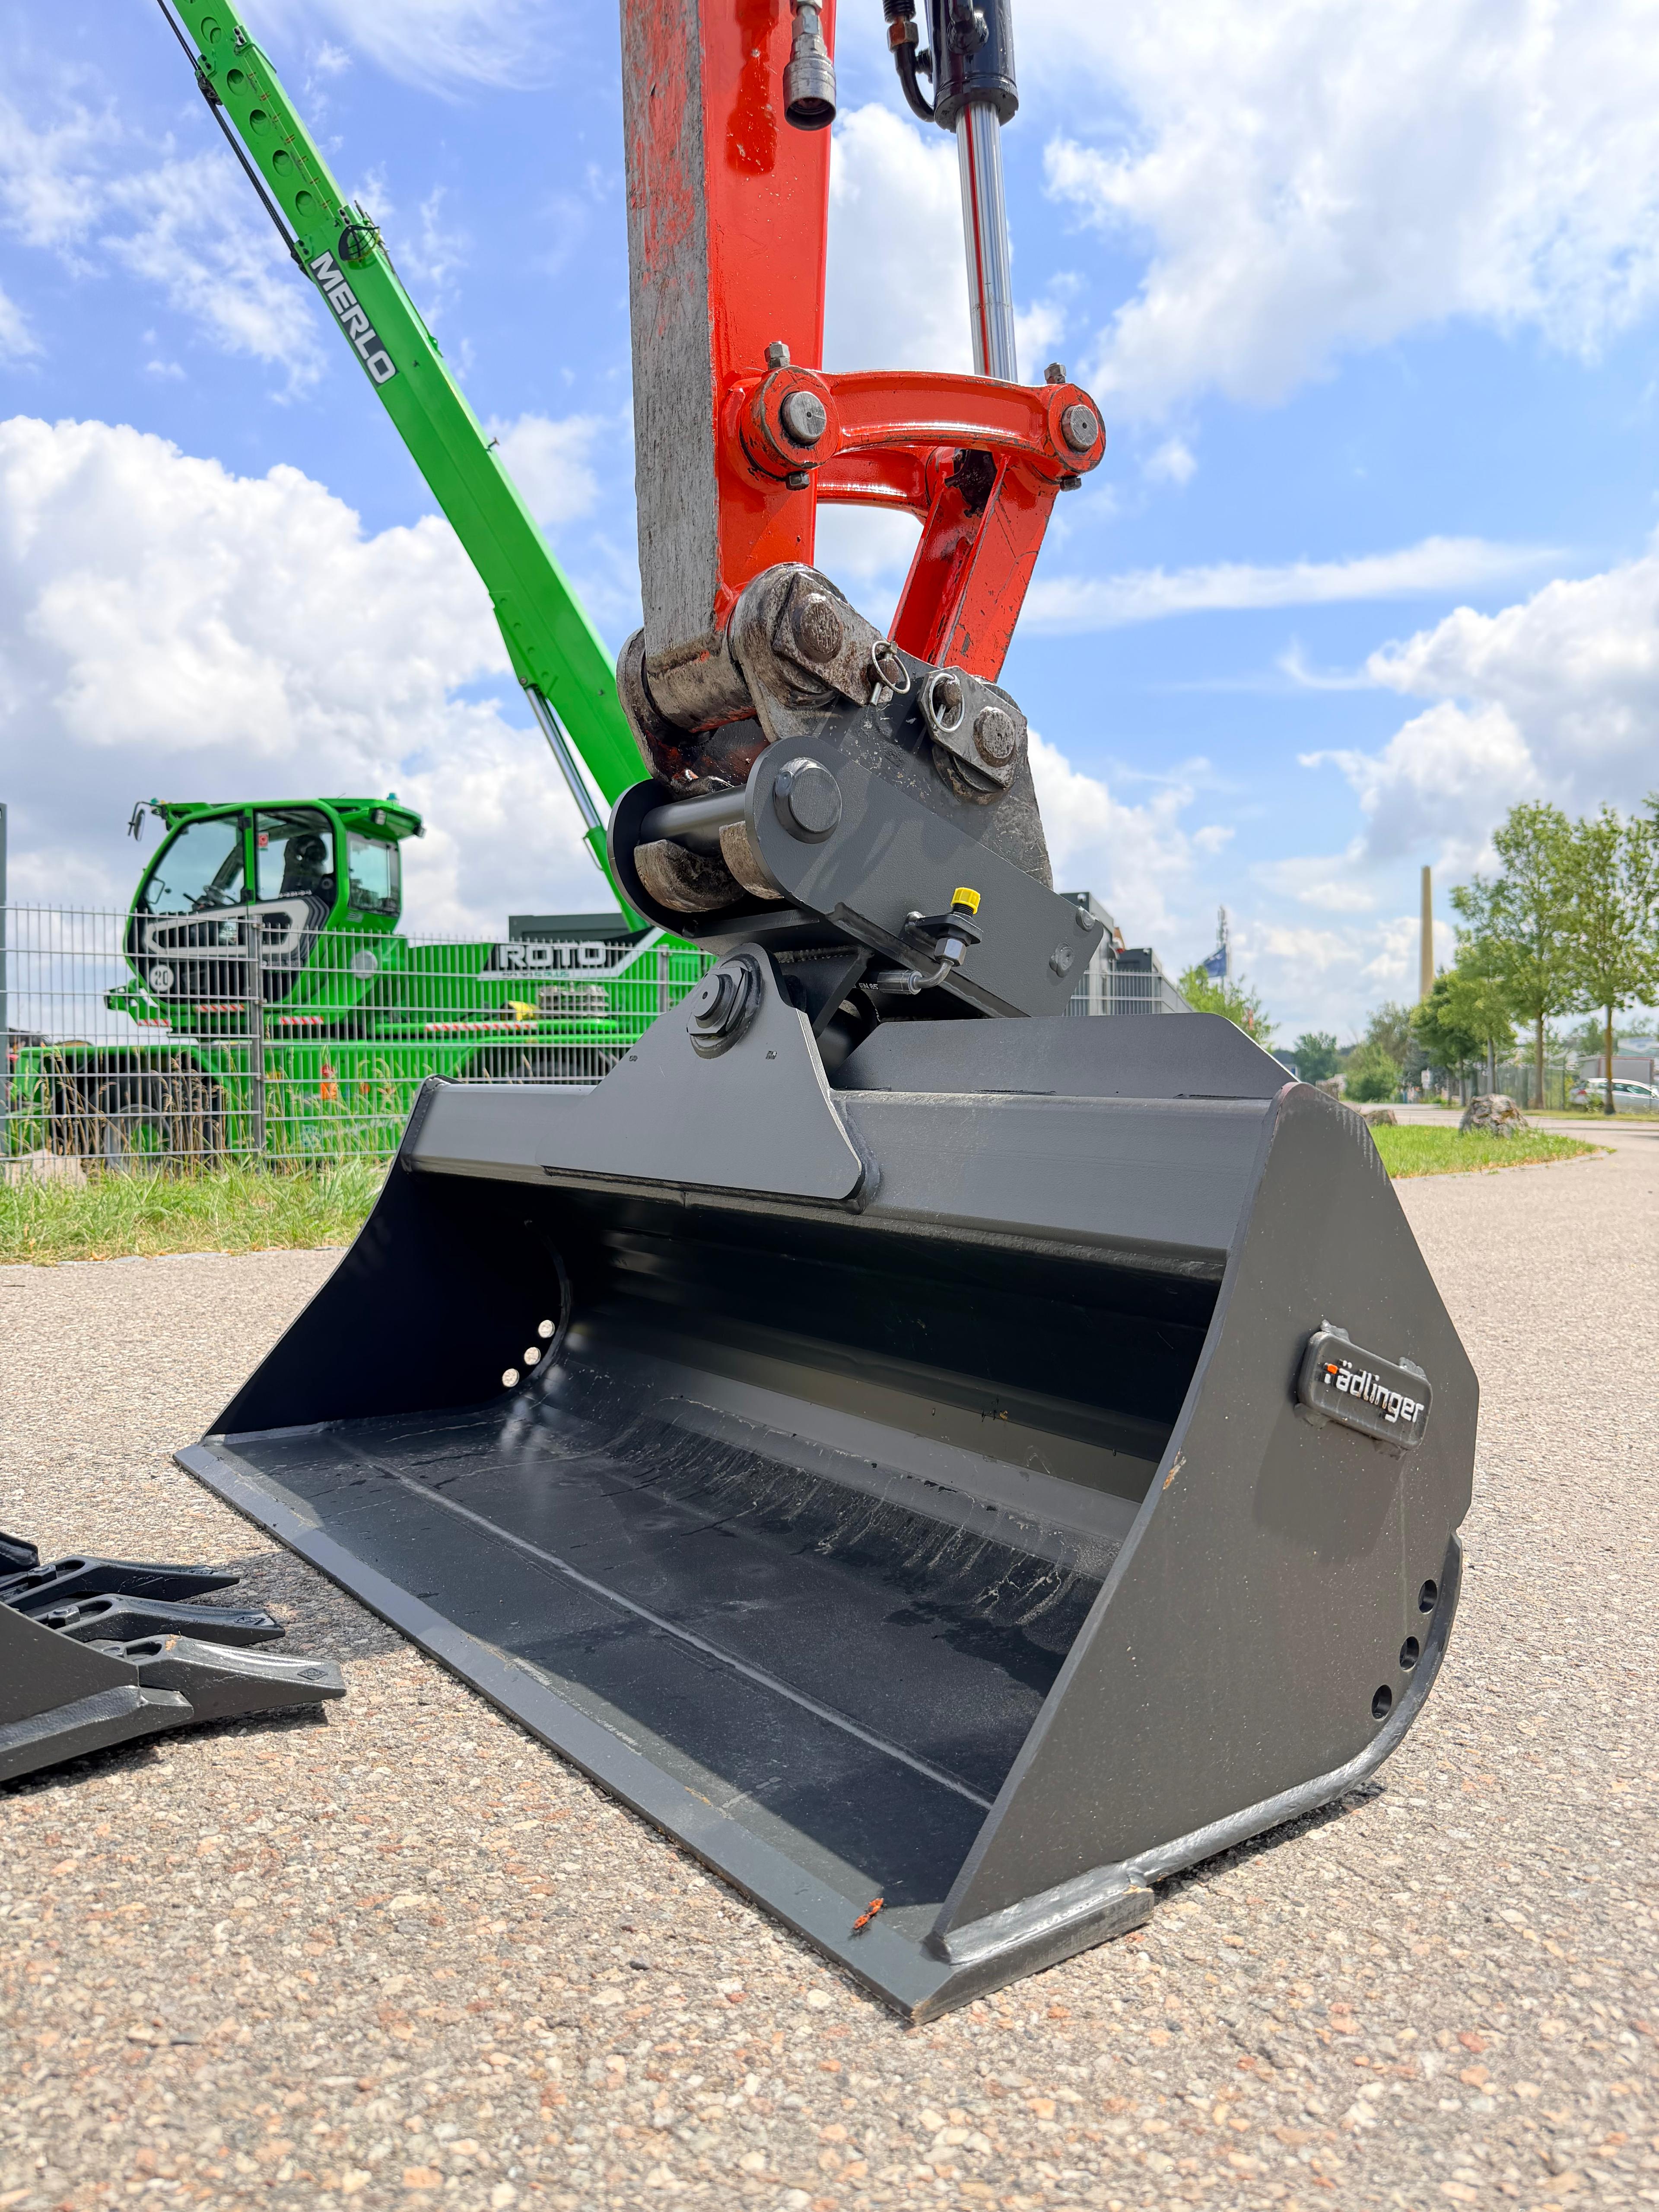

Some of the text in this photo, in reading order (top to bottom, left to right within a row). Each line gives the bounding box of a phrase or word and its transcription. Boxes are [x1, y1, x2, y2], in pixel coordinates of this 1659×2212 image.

[310, 251, 396, 384] MERLO
[499, 941, 607, 967] ROTO
[155, 970, 168, 985] 20
[1324, 1359, 1424, 1423] rädlinger
